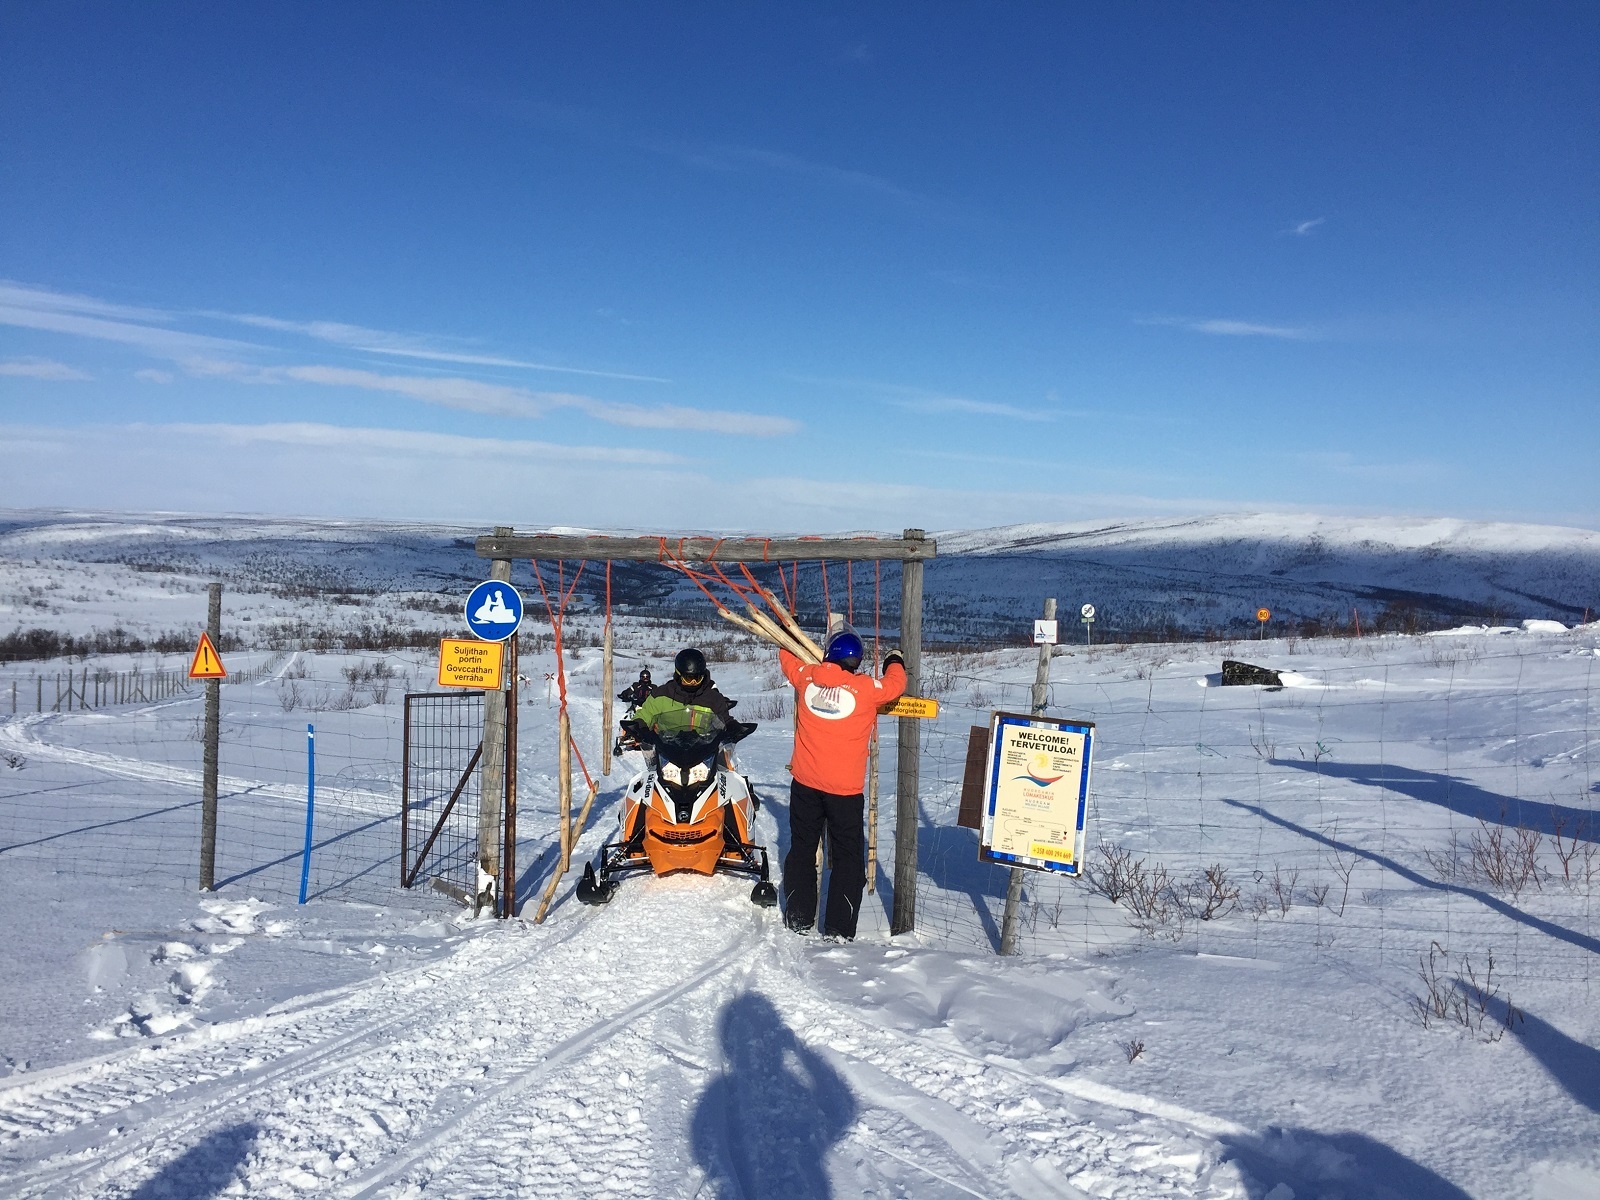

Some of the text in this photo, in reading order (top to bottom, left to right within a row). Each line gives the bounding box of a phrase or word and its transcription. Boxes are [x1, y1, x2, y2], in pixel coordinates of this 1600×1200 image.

[458, 655, 482, 663] portin
[1018, 731, 1069, 745] WELCOME!
[1010, 739, 1077, 755] TERVETULOA!
